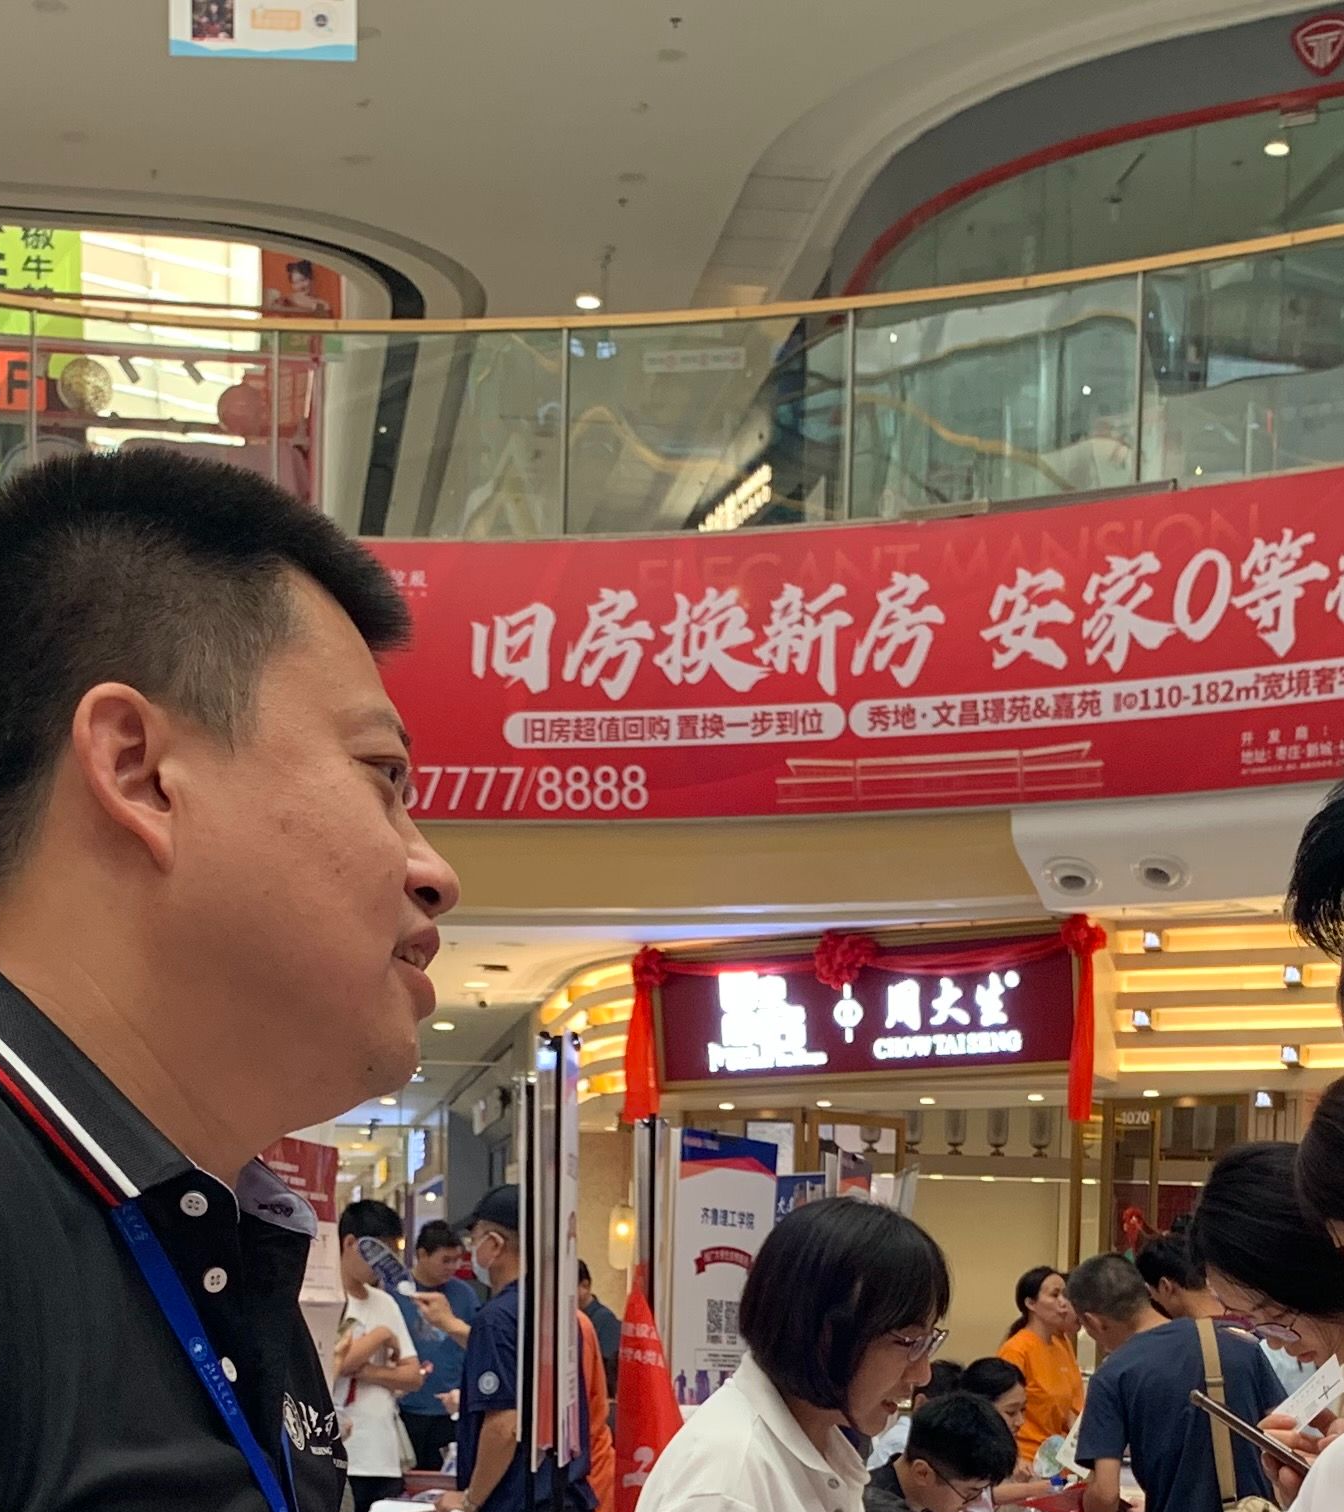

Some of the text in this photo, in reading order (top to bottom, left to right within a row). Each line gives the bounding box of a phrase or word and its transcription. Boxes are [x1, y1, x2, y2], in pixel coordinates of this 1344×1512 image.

[469, 570, 946, 701] 旧房换新房
[522, 706, 825, 747] 旧房超值回购 置换一步到位
[884, 970, 1009, 1032] 周大生
[1120, 1111, 1150, 1125] 1070
